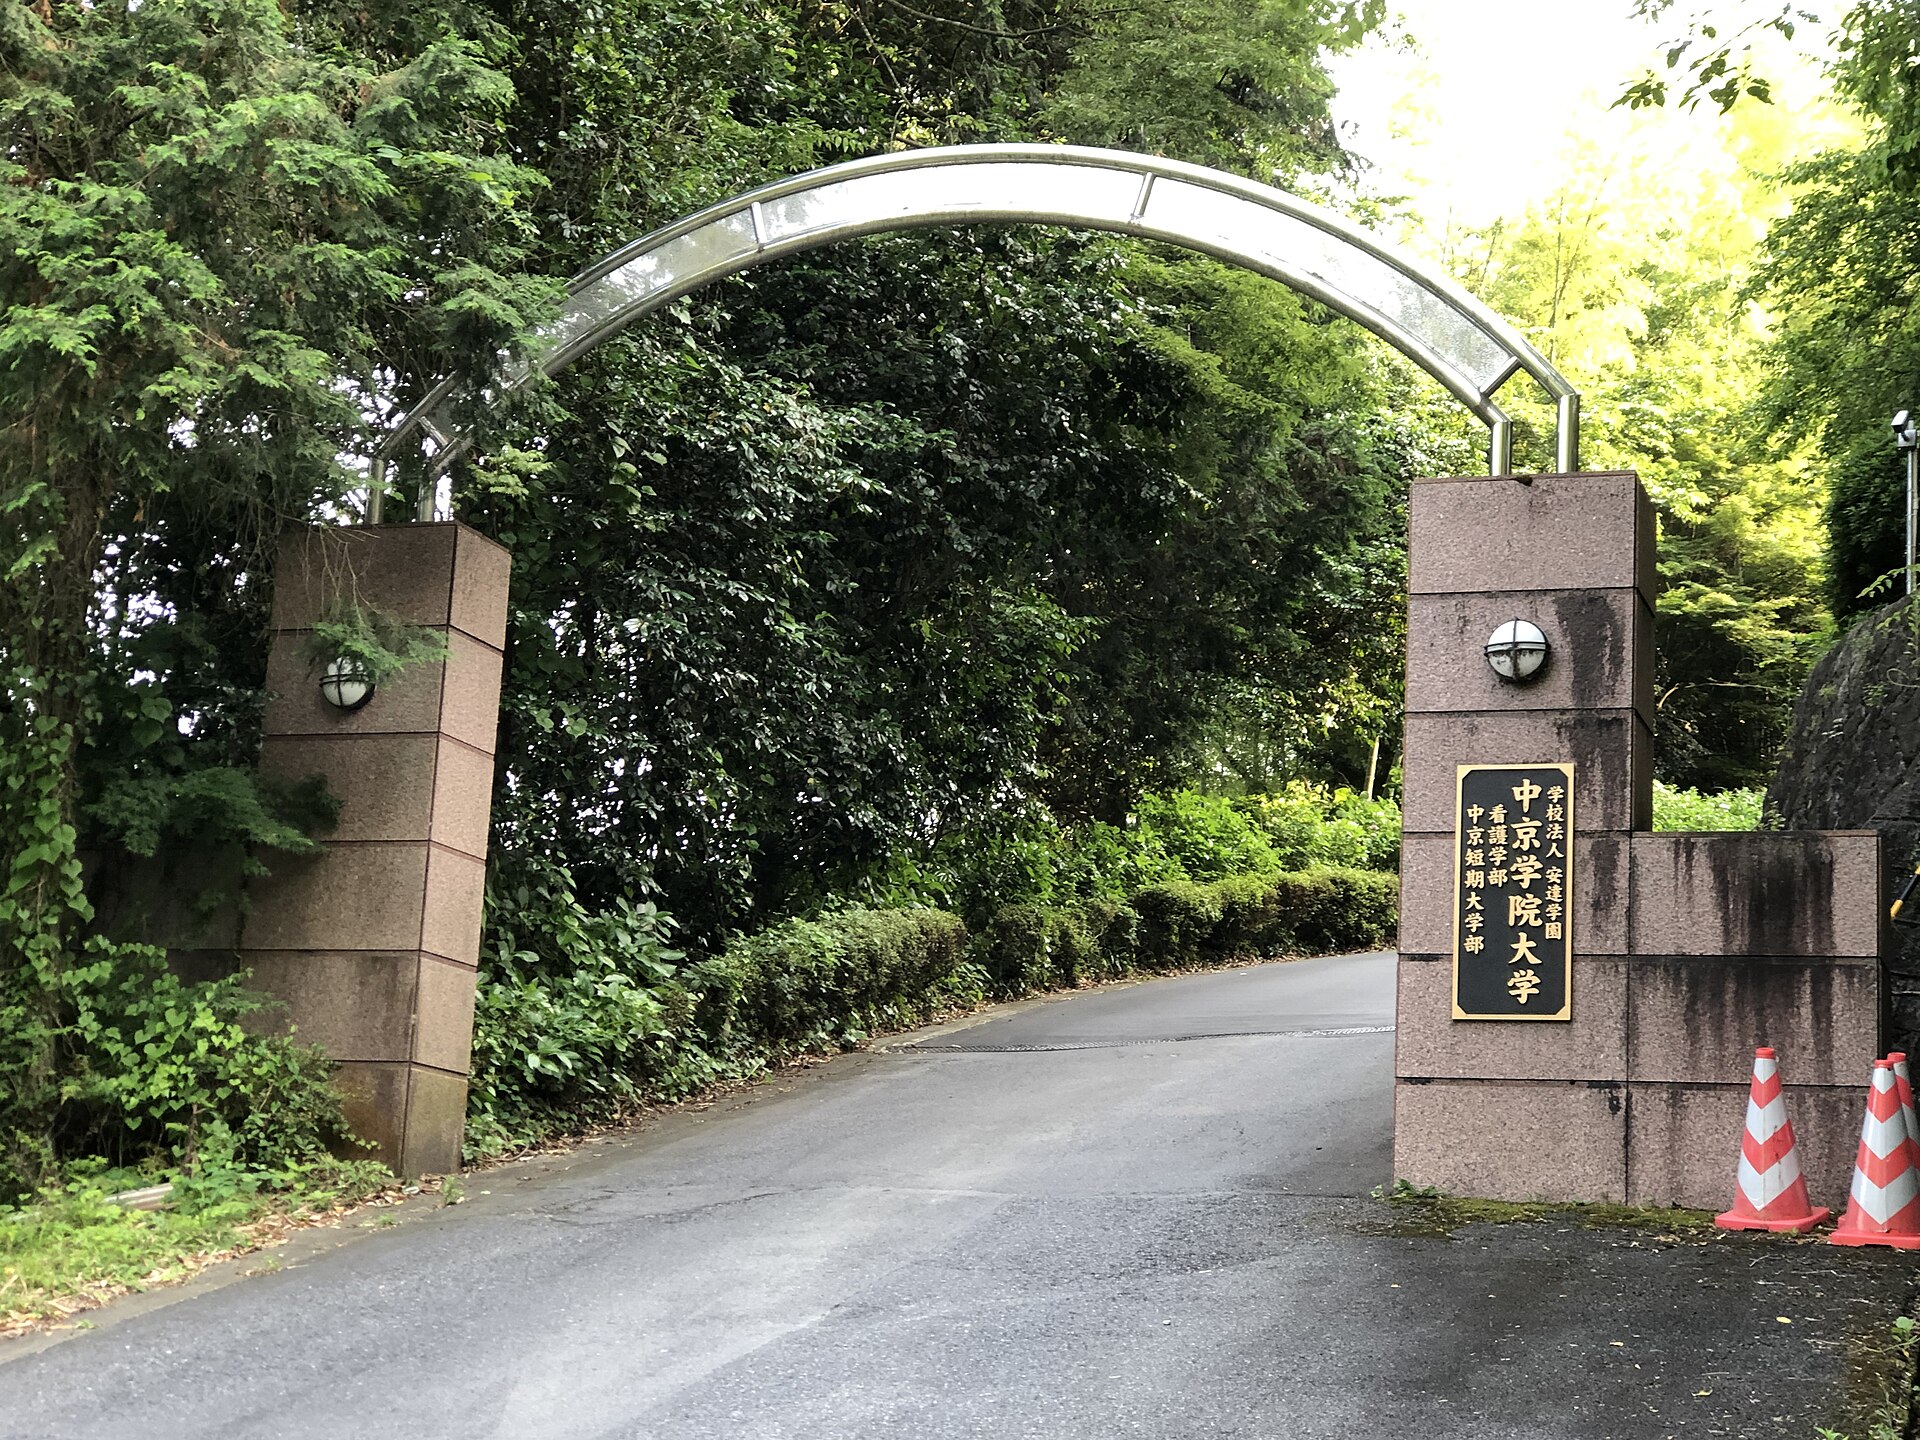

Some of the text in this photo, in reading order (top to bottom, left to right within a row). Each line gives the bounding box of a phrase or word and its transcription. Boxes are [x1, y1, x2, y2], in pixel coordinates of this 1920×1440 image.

[1463, 803, 1486, 955] 中京短期大学部
[1487, 803, 1509, 888] 看護学部
[1507, 778, 1544, 1005] 中京学院大学
[1544, 785, 1565, 940] 学校法人 安達学園
